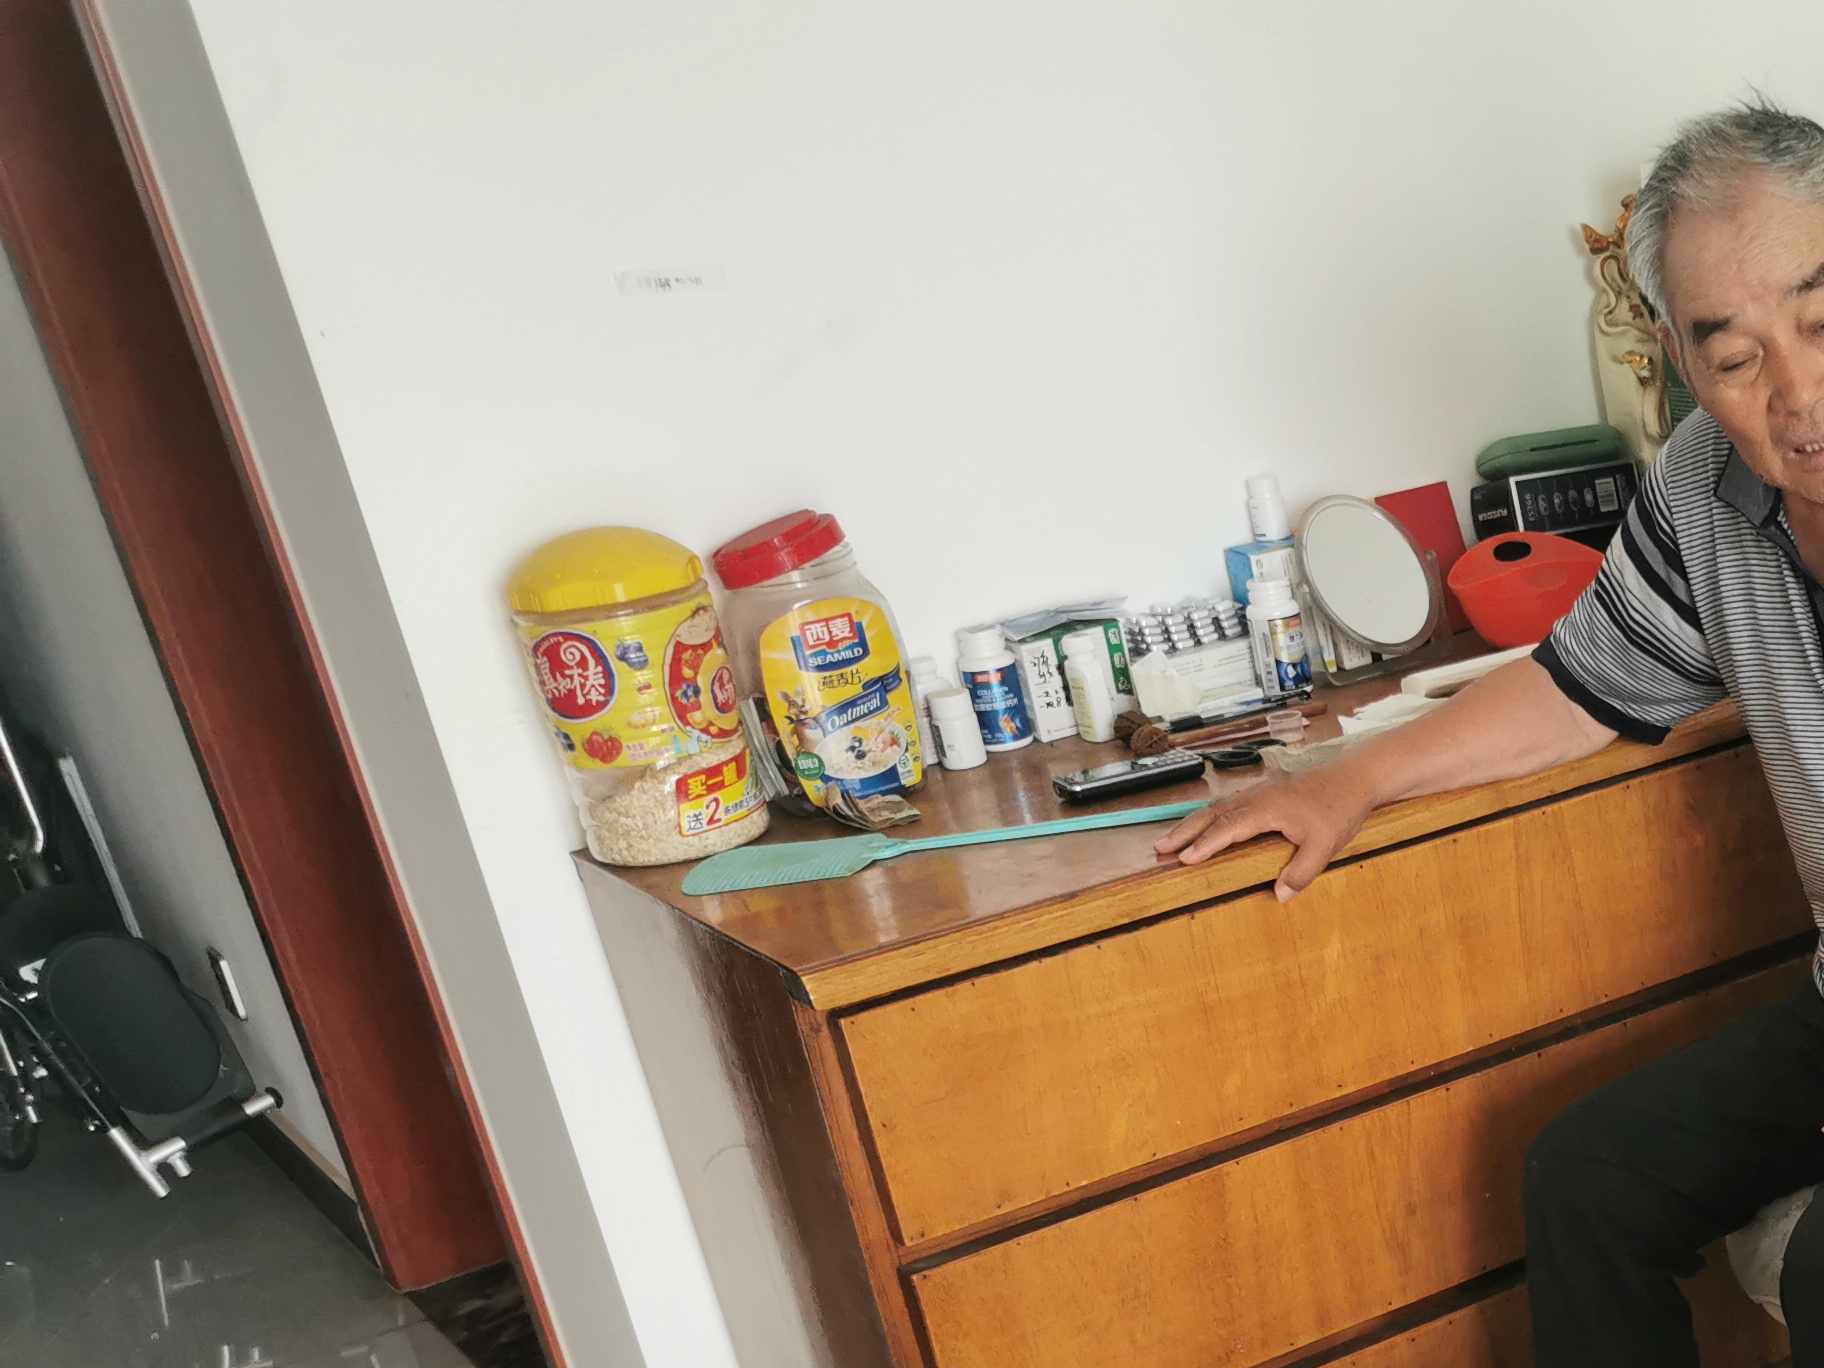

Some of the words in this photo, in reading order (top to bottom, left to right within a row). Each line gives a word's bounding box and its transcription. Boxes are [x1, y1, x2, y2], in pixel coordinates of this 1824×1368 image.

[803, 616, 854, 646] 西麦
[807, 647, 863, 667] SEAMILD
[827, 692, 881, 733] Oatmeal
